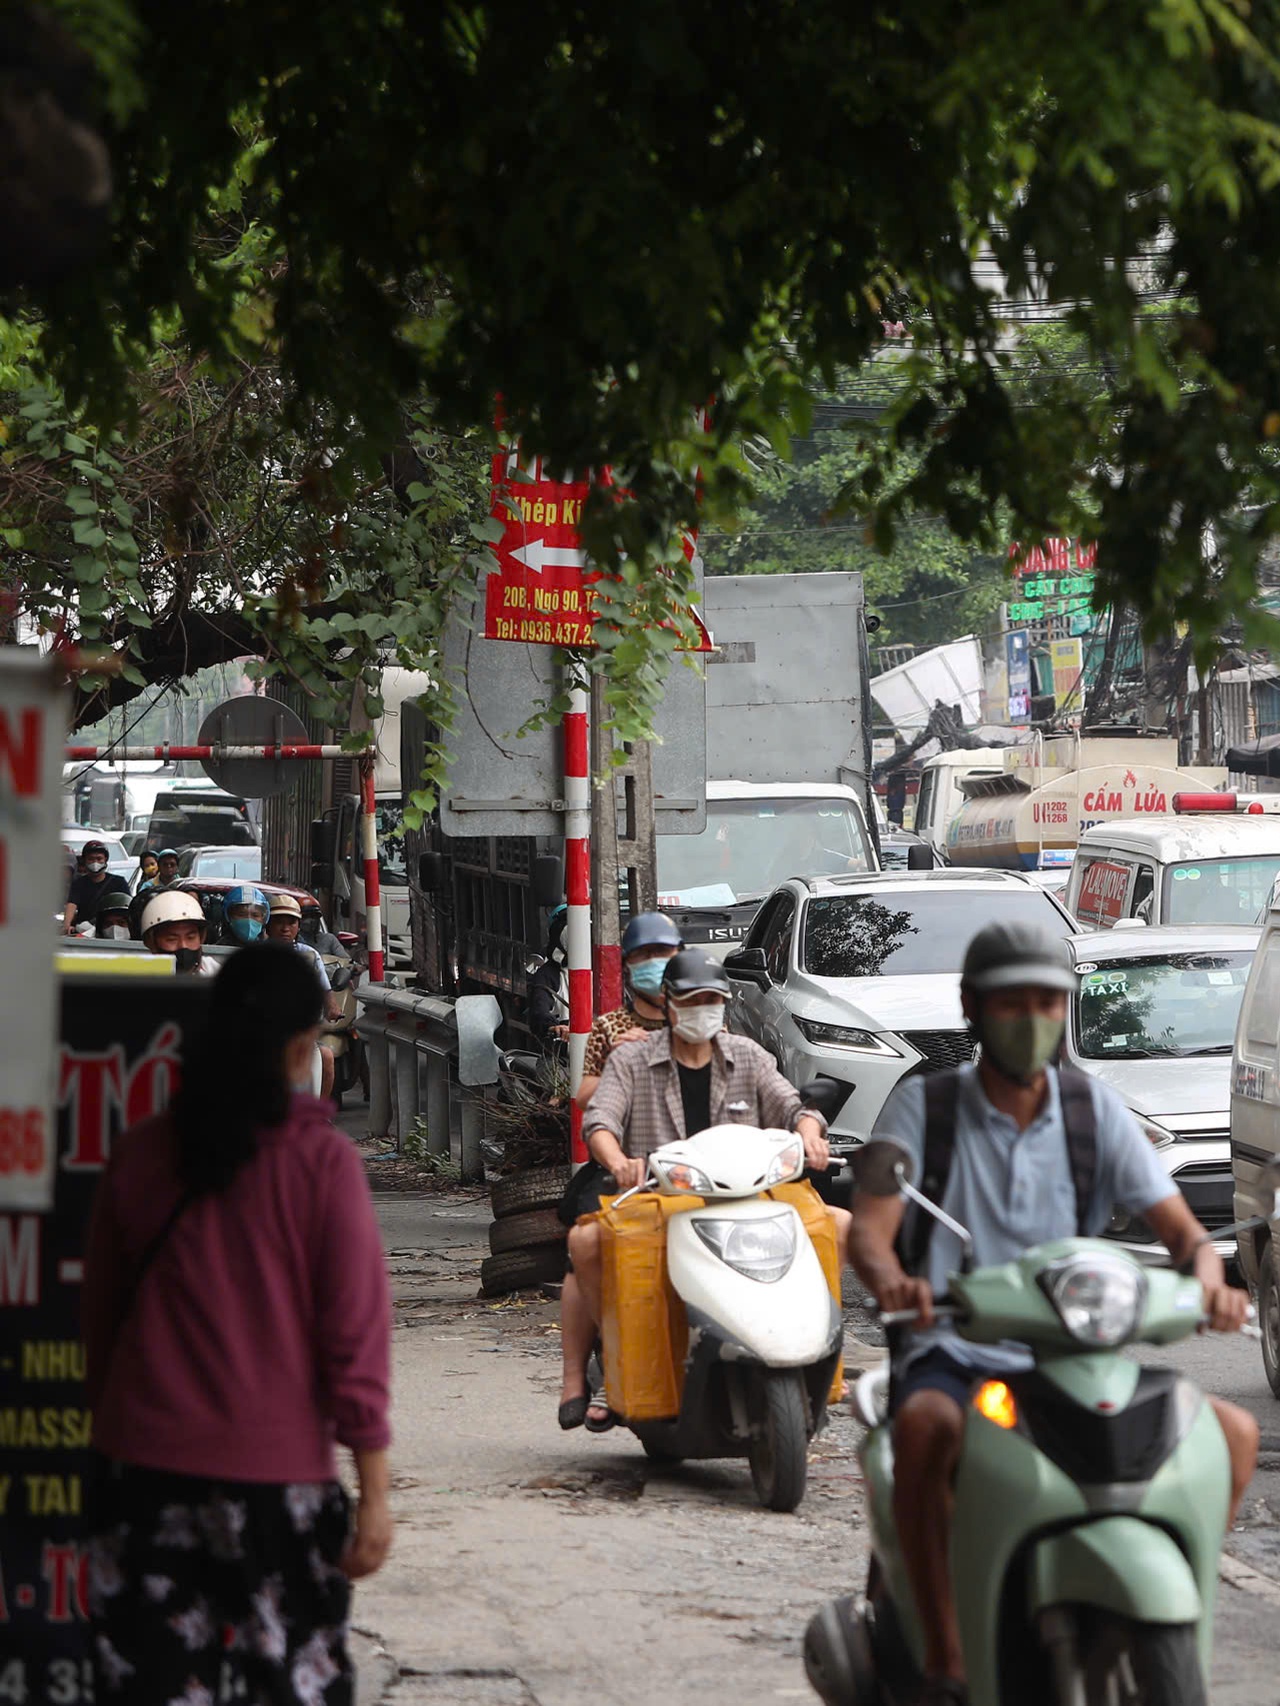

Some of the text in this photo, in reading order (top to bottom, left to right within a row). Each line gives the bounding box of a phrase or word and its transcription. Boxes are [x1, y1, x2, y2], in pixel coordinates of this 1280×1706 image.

[562, 591, 582, 614] 90,
[496, 618, 518, 640] Tel:
[1084, 782, 1167, 812] CẤM LỬA
[1046, 802, 1067, 811] 1202
[1047, 813, 1068, 823] 1268
[1088, 982, 1128, 996] TAXI
